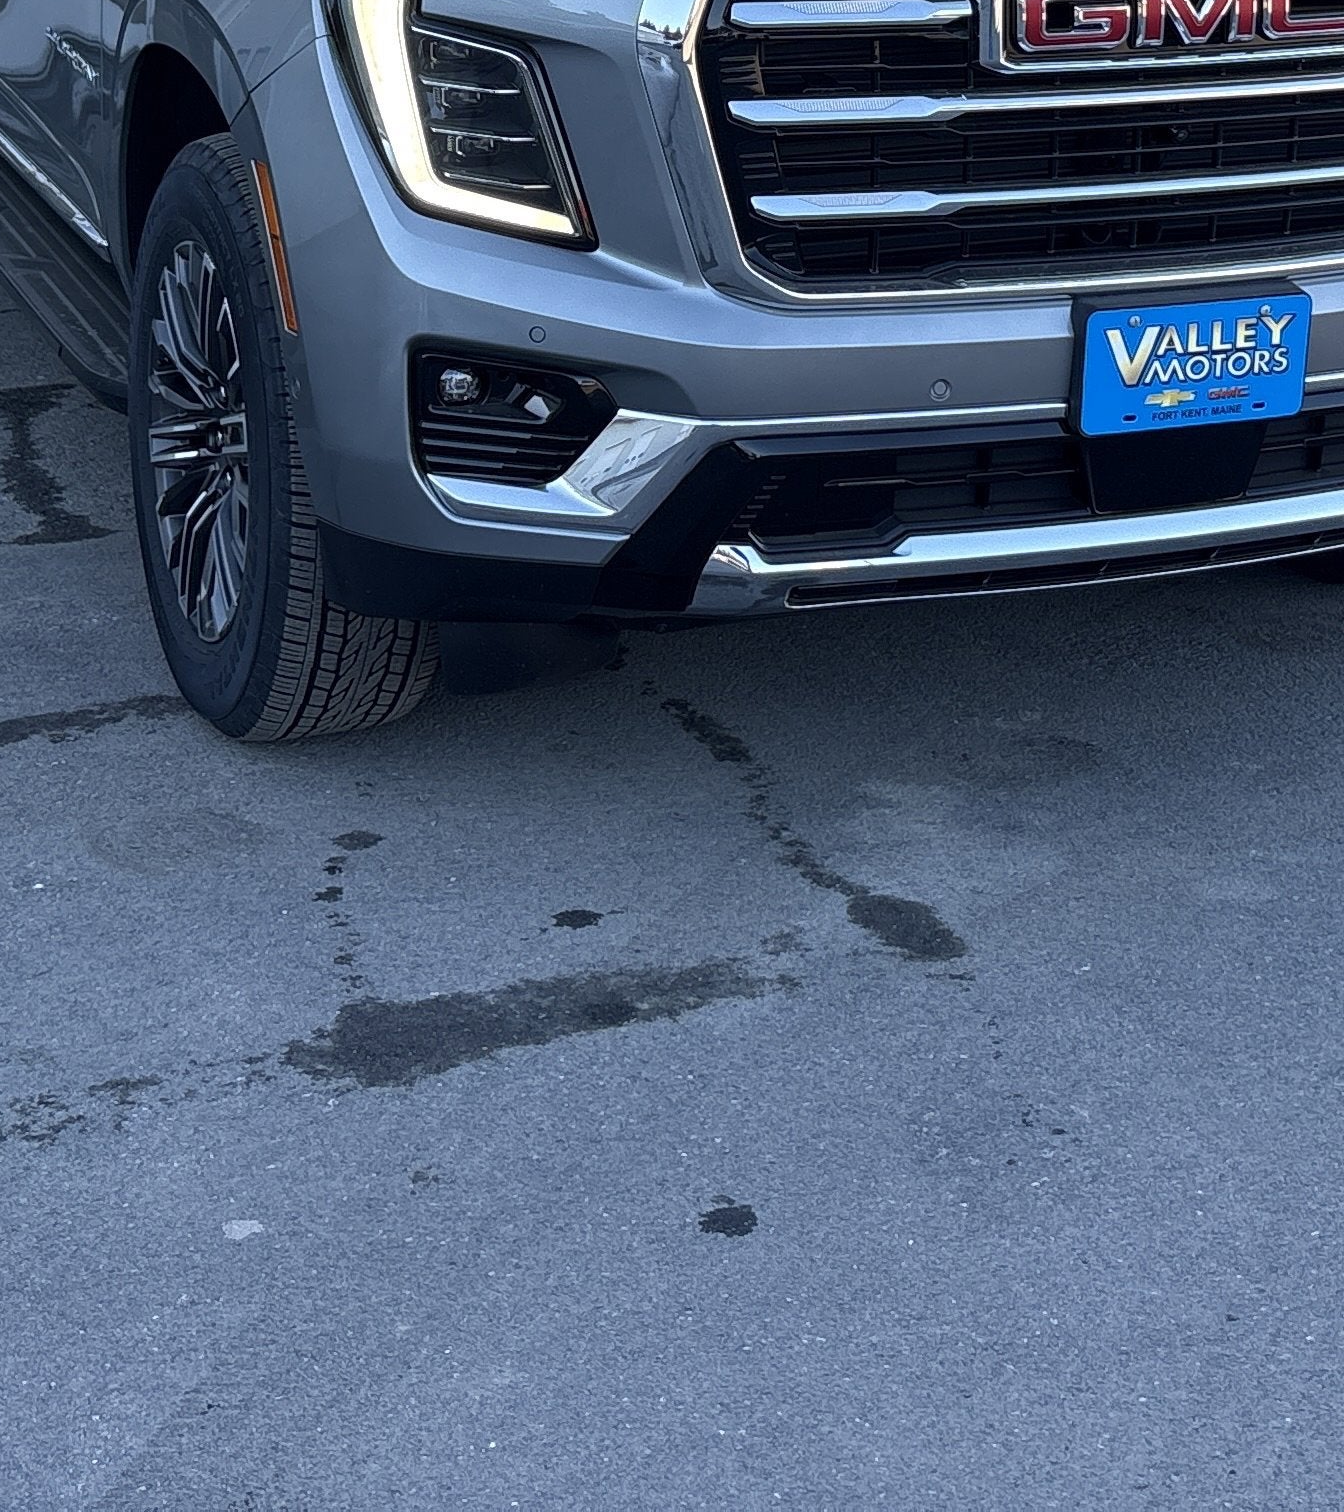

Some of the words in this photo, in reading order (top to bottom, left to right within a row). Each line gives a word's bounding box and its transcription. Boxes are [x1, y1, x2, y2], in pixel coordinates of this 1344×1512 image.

[1103, 313, 1296, 387] VALLEY
[1142, 346, 1289, 384] MOTORS
[1152, 410, 1179, 422] FORT
[1211, 404, 1243, 416] MAINE
